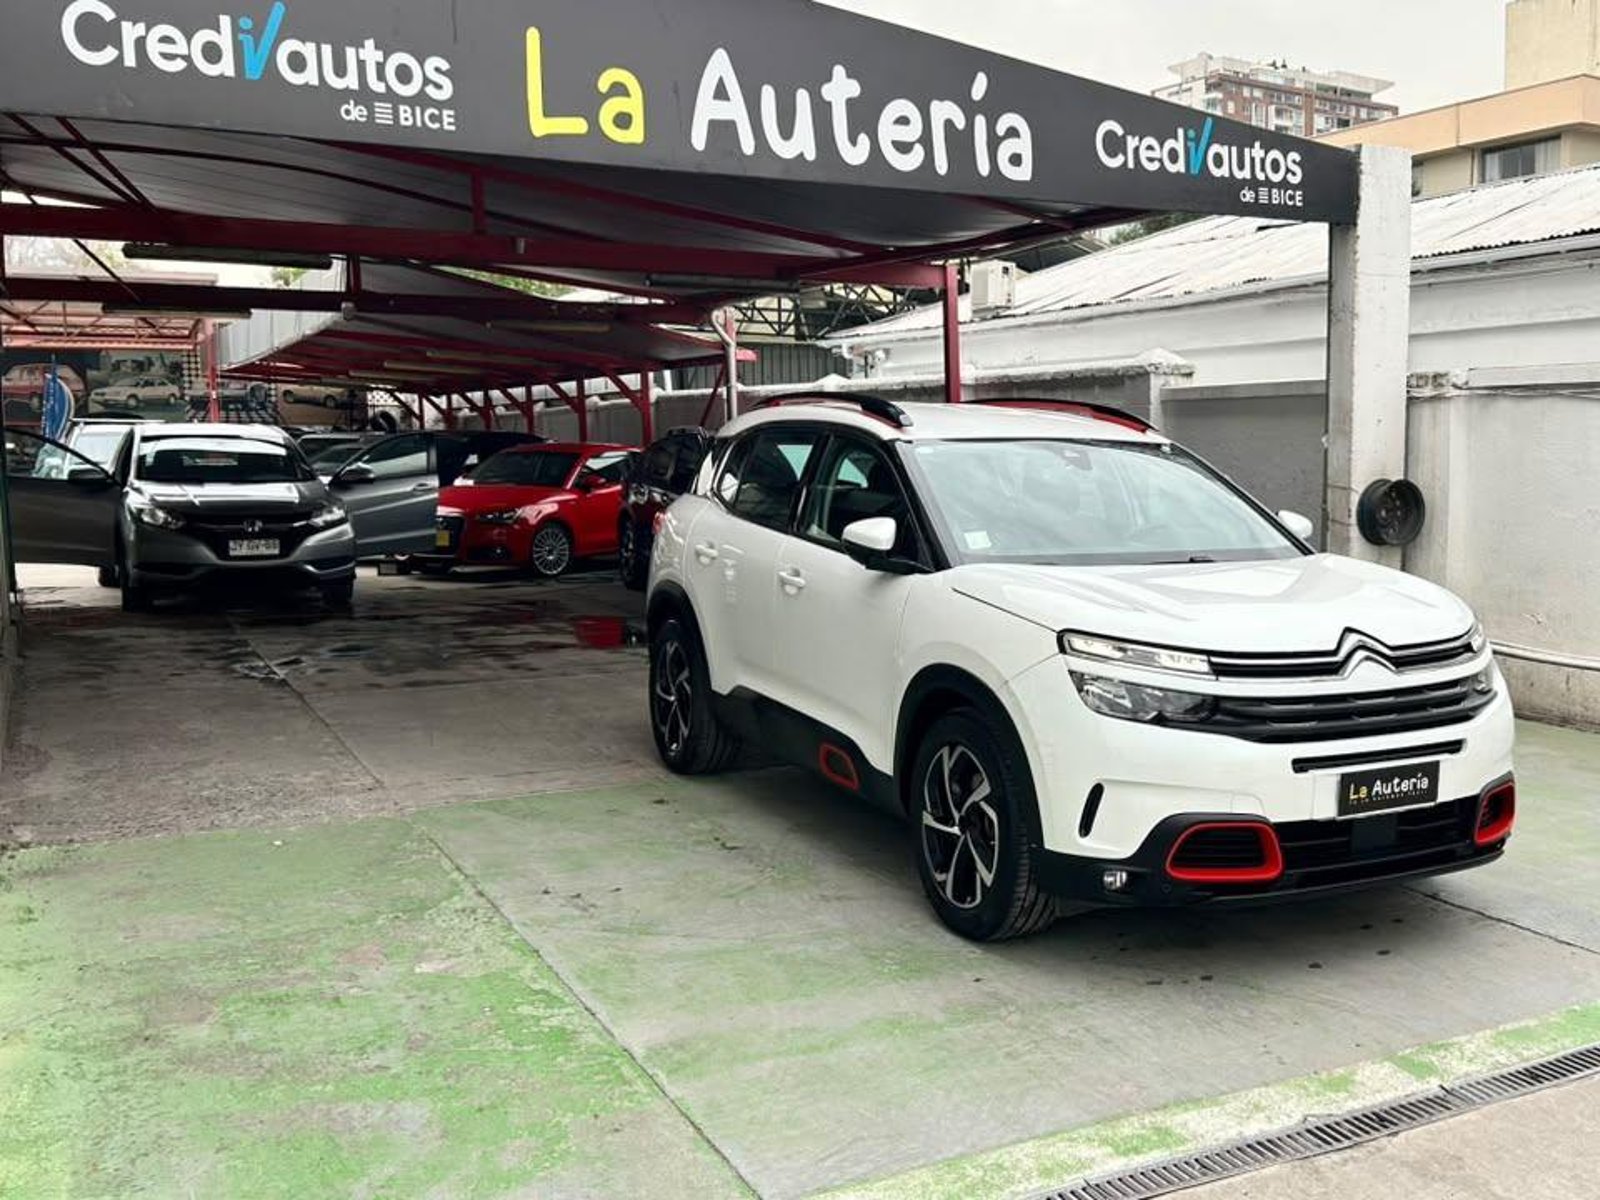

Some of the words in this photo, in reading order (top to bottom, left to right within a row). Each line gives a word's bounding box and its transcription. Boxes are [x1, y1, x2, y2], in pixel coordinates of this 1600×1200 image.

[340, 101, 369, 123] de
[399, 104, 457, 131] BICE
[526, 26, 645, 145] La
[691, 47, 1034, 182] Autería
[1239, 187, 1256, 203] de
[1271, 187, 1304, 207] BICE
[1349, 783, 1368, 800] La
[1371, 772, 1429, 797] Autería
